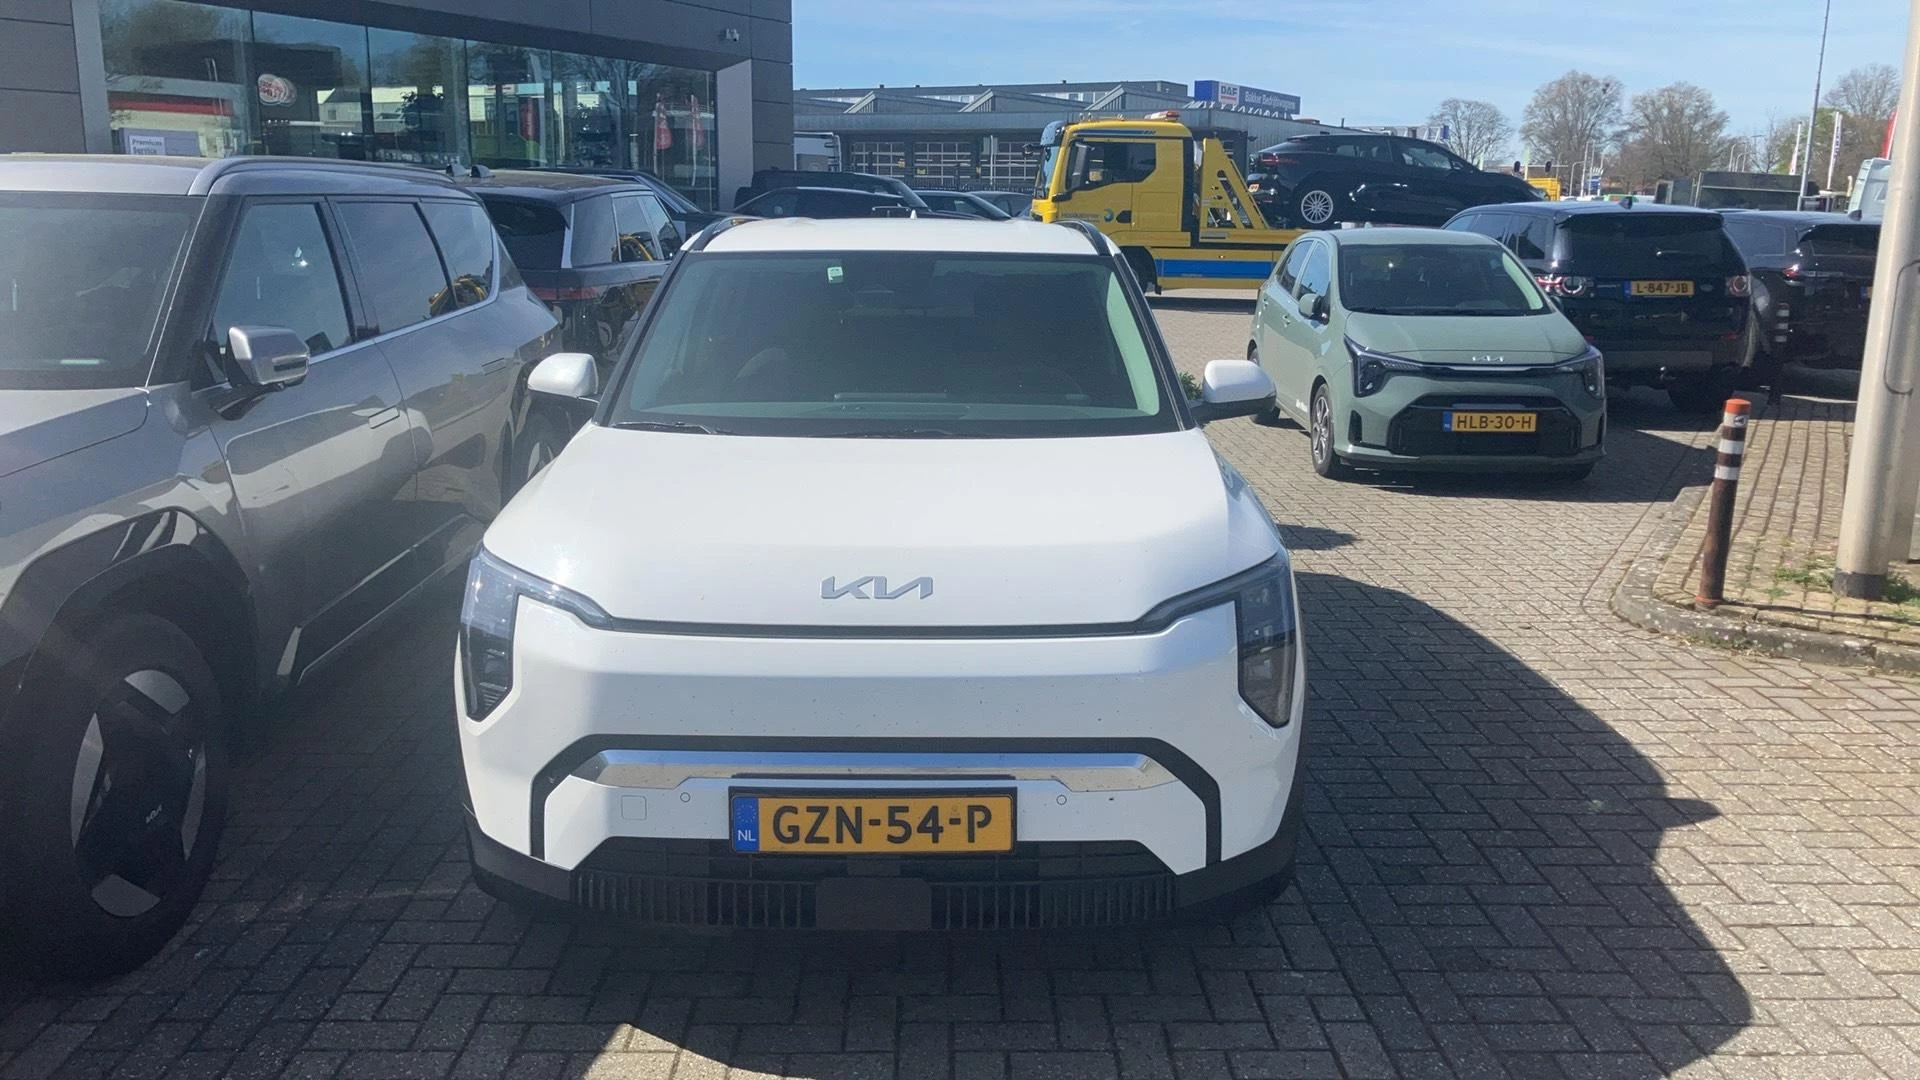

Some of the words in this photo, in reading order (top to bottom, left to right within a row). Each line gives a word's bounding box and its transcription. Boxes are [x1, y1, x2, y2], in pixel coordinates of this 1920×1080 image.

[1220, 85, 1239, 96] DAF
[1635, 282, 1689, 294] L-847-JB
[1456, 415, 1532, 429] HLB-30-H
[821, 575, 934, 600] KIA
[772, 804, 993, 845] GZN-54-P
[737, 829, 757, 842] NL
